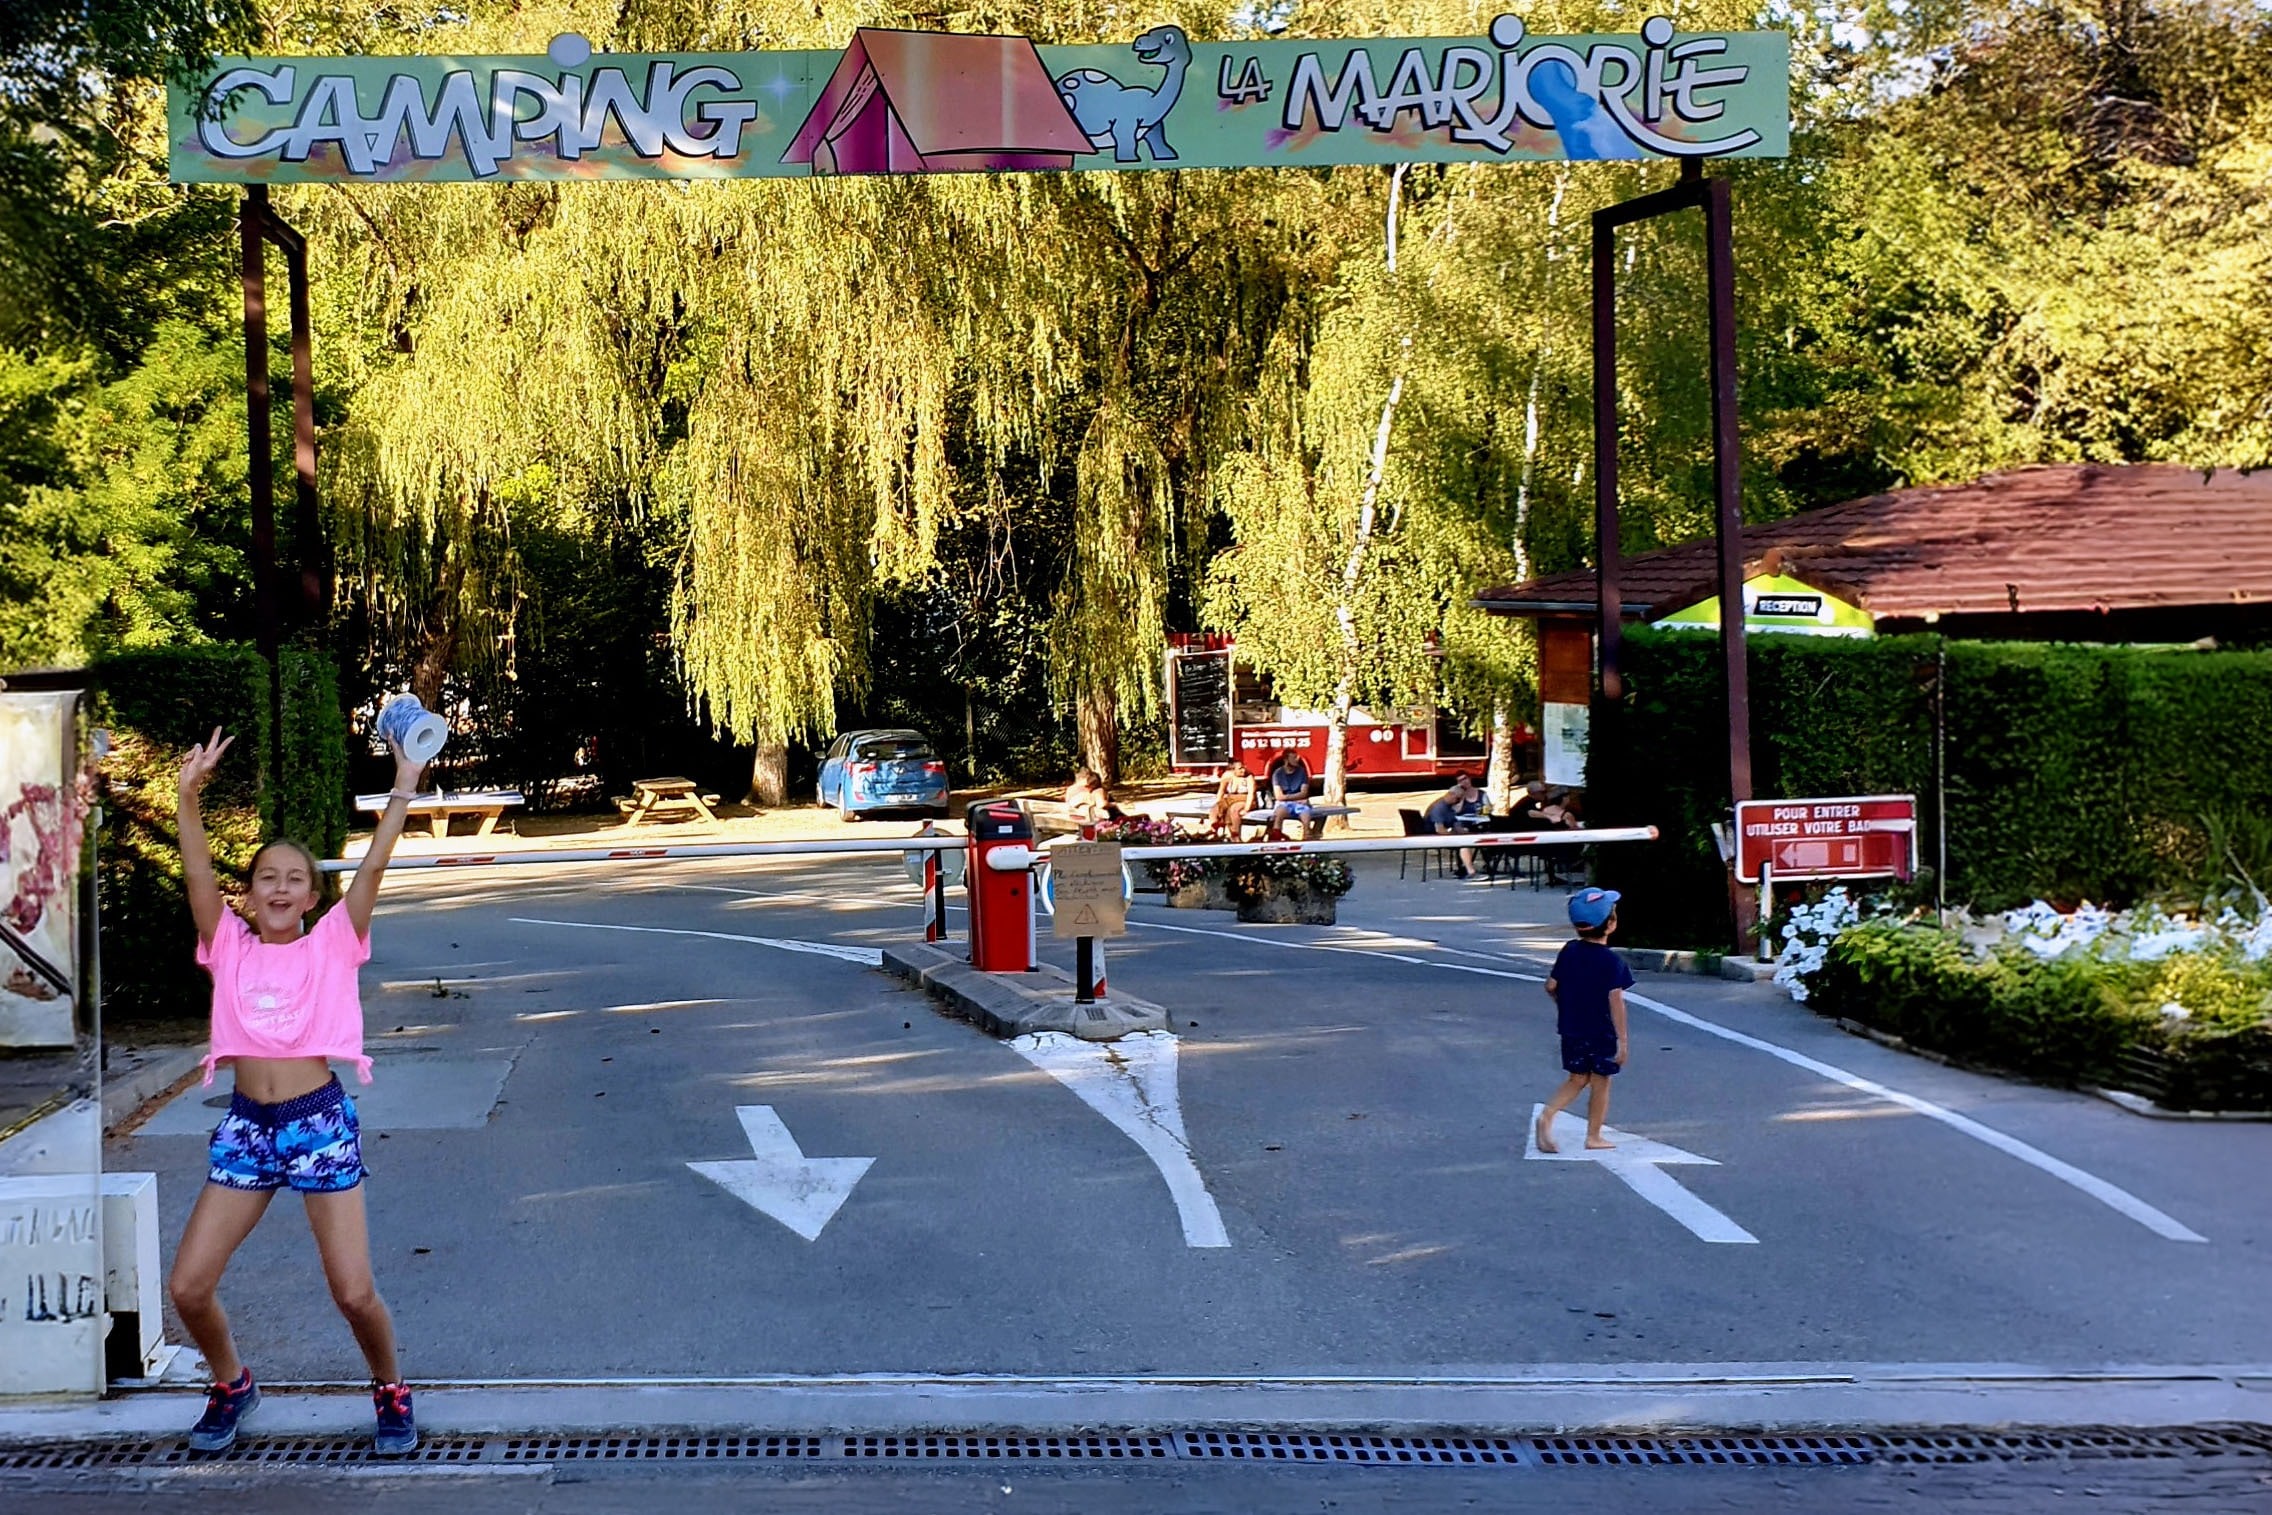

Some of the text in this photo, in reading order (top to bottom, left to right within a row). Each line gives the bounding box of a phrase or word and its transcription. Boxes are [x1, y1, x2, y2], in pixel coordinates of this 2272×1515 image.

[1217, 55, 1273, 105] LA
[1758, 599, 1818, 613] RECEPTION
[1774, 805, 1860, 820] POUR ENTRER
[1746, 819, 1871, 836] UTILISER VOTRE BAD
